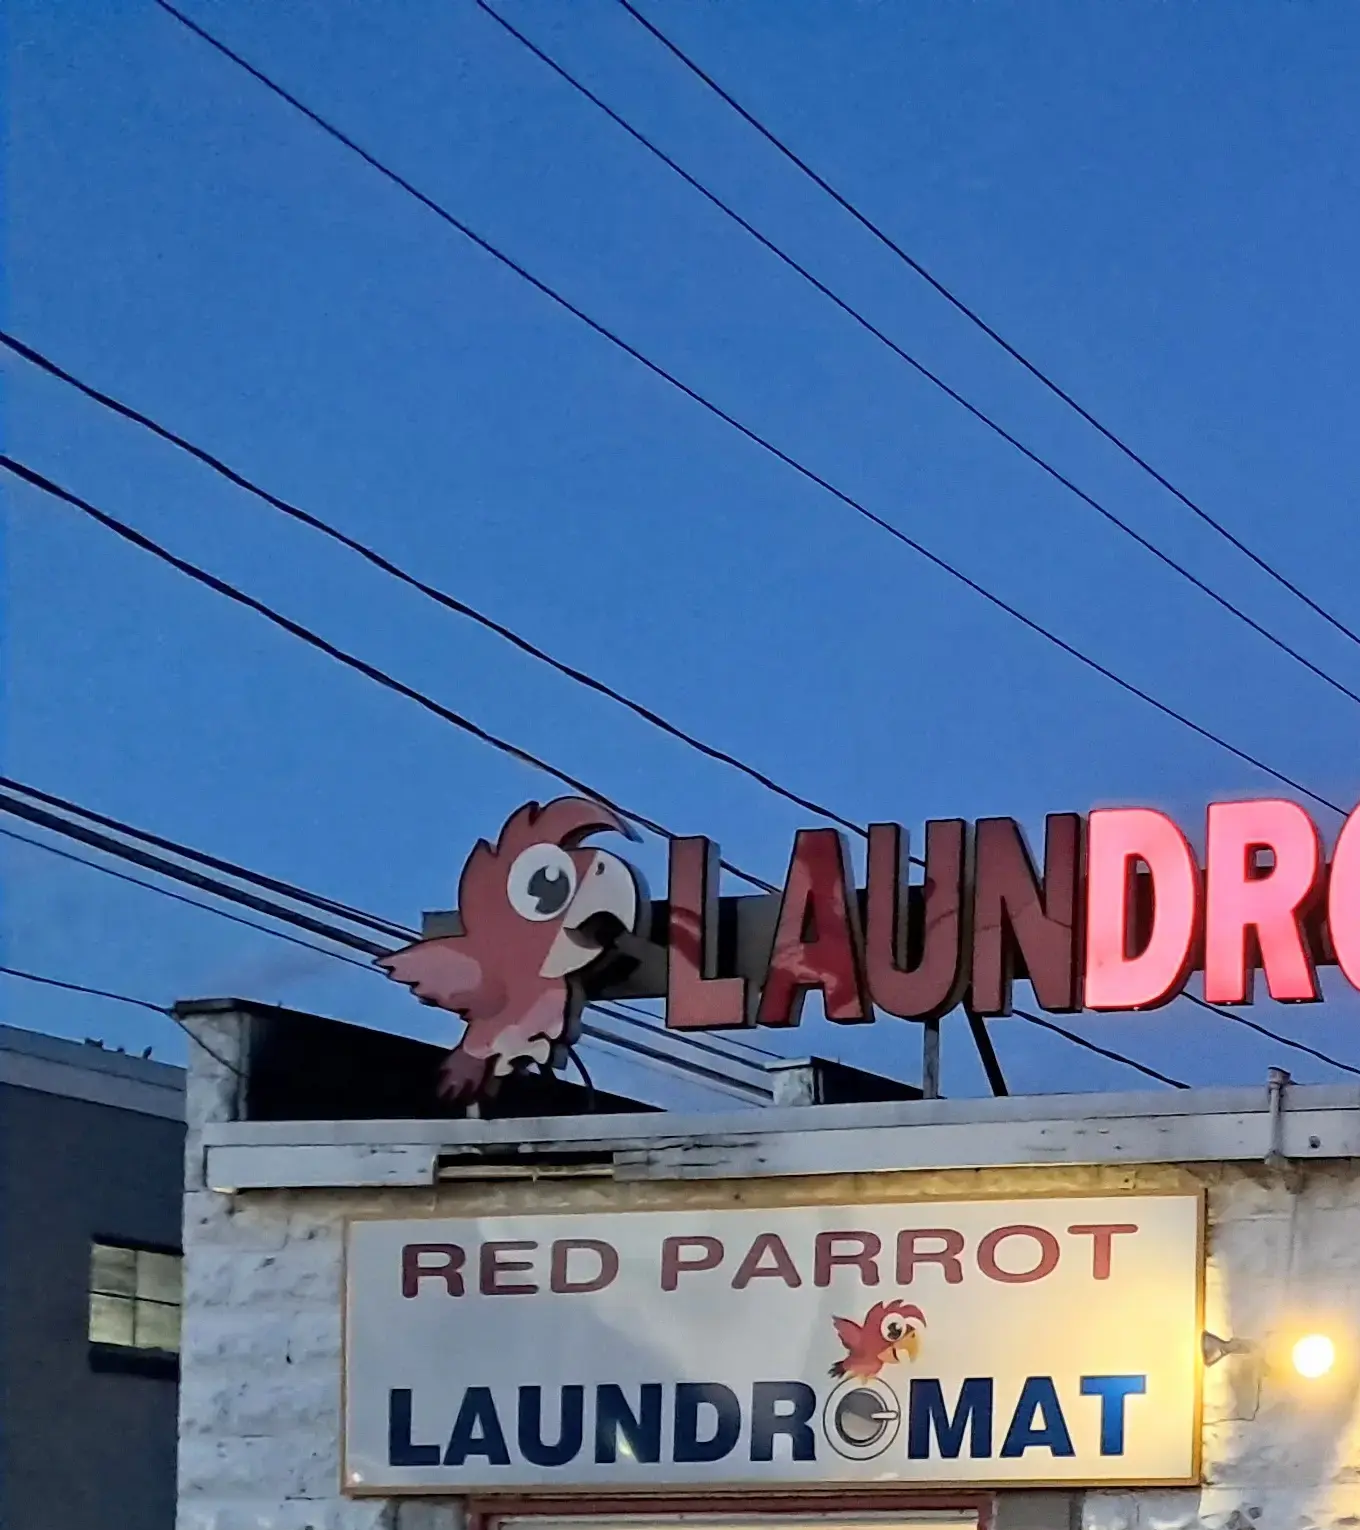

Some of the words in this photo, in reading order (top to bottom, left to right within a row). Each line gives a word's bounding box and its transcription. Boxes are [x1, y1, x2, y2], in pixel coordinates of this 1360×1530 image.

[401, 1238, 620, 1298] RED
[661, 1223, 1139, 1292] PARROT
[388, 1375, 1147, 1467] LAUNDROMAT
